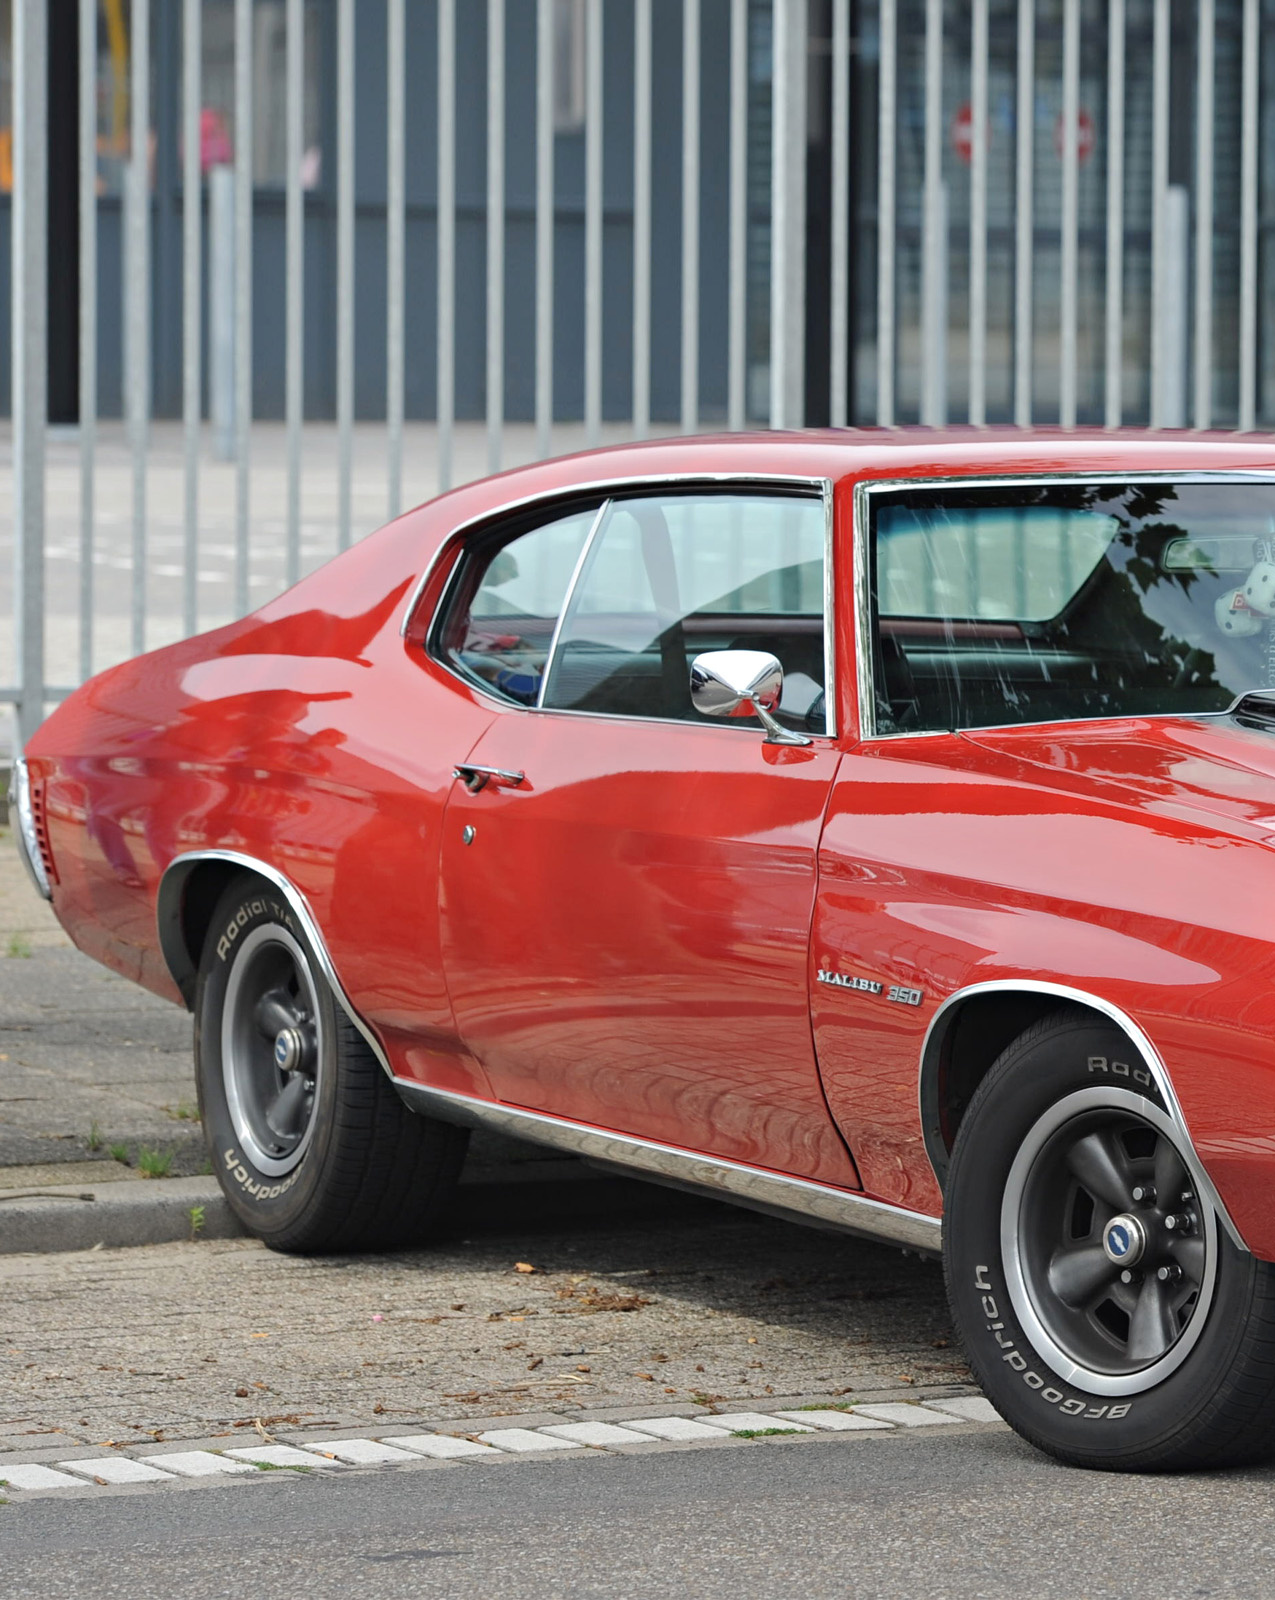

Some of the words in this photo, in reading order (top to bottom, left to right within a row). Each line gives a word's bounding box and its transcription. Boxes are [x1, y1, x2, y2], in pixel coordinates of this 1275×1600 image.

[216, 899, 268, 962] Radial
[817, 969, 882, 995] MALIBU
[886, 985, 924, 1007] 350
[975, 1265, 1132, 1420] BFGoodrich
